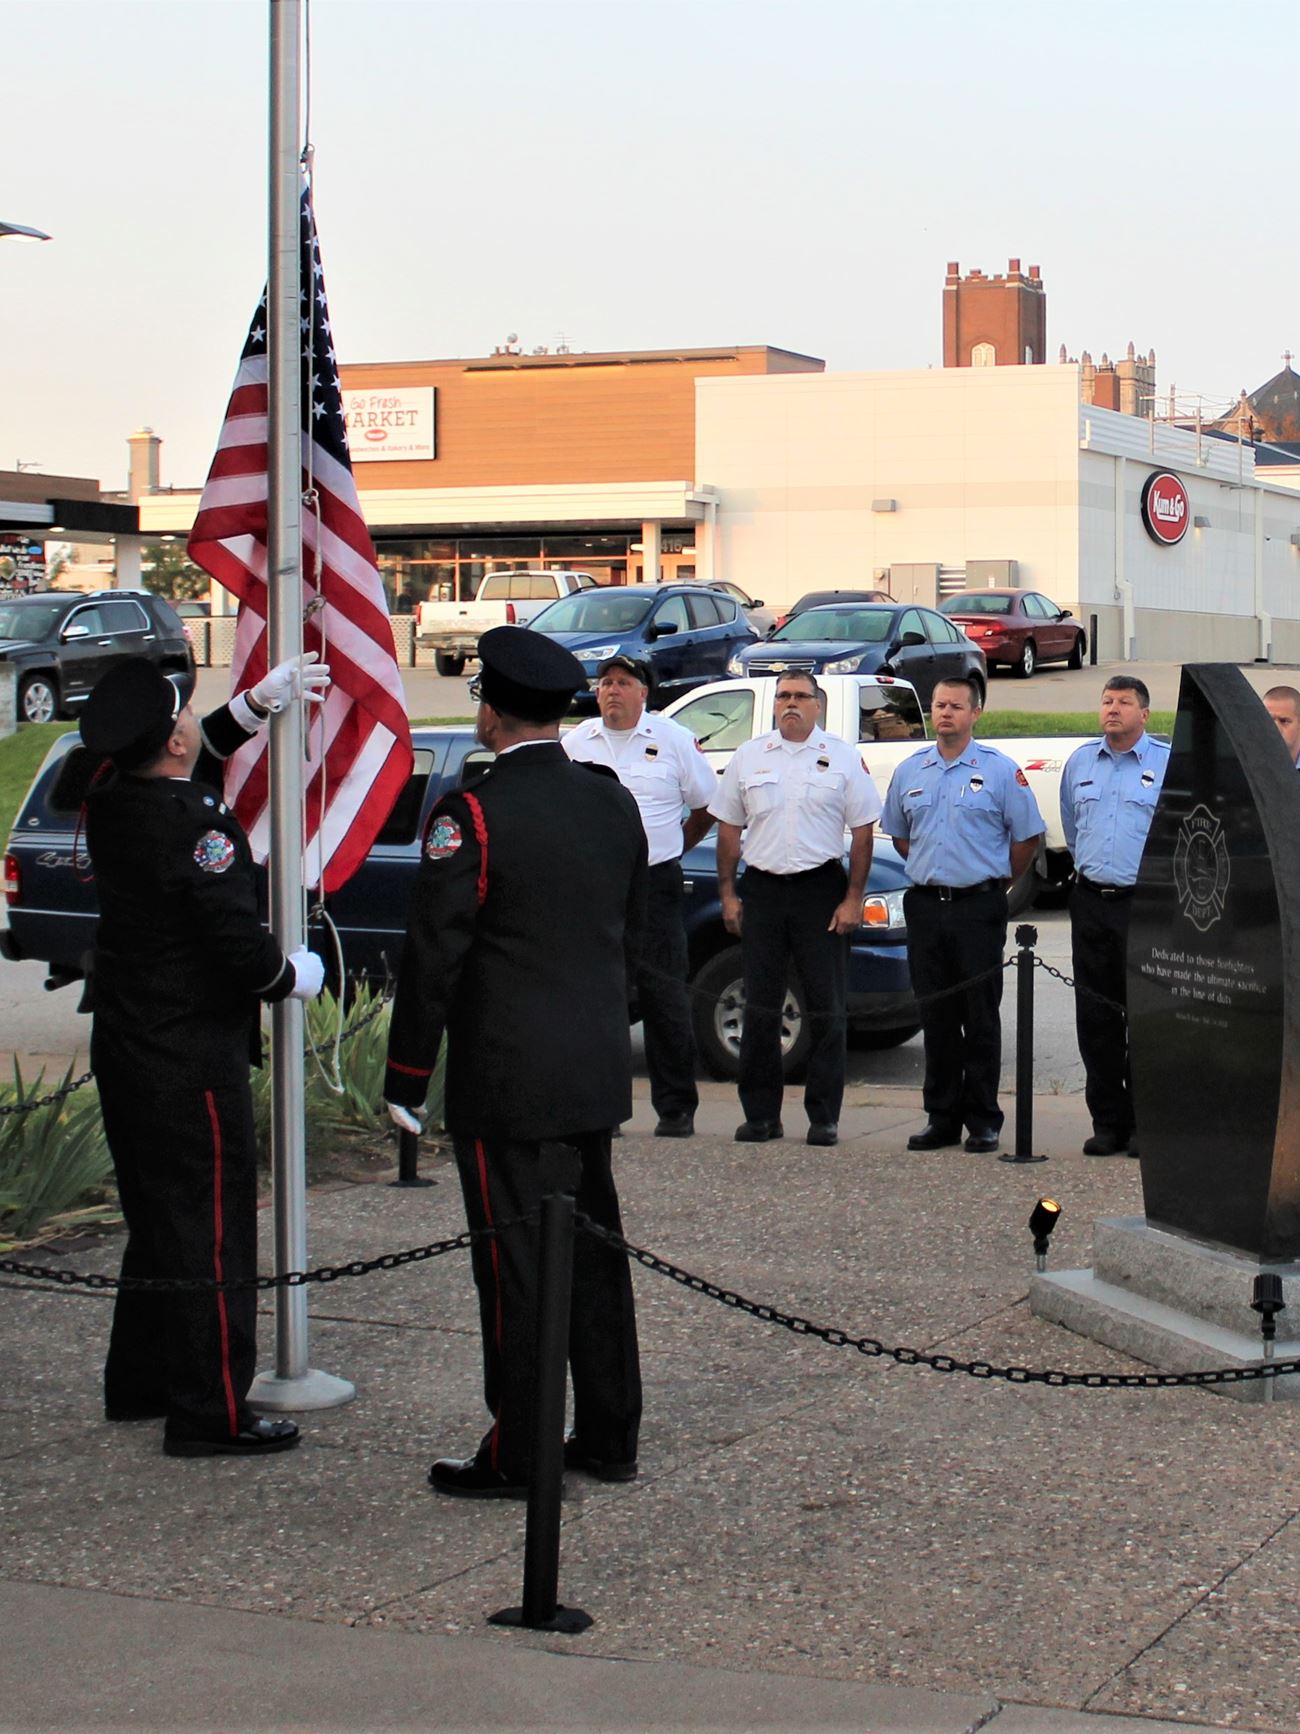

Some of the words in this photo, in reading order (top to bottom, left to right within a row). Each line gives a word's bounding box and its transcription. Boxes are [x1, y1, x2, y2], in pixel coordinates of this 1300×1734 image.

[350, 397, 366, 410] Go
[369, 396, 401, 410] Fresh
[1191, 816, 1212, 833] FIRE
[1151, 947, 1185, 963] Dedicated
[1186, 954, 1194, 964] to
[1196, 953, 1215, 968] those
[1141, 962, 1156, 974] who
[1156, 964, 1172, 978] have
[1173, 969, 1191, 981] made
[1194, 971, 1205, 983] the
[1207, 973, 1235, 989] ultimate
[1237, 980, 1267, 994] sacrifice
[1171, 986, 1178, 995] in
[1180, 985, 1191, 998] the
[1193, 987, 1205, 1000] line
[1207, 991, 1215, 1001] of
